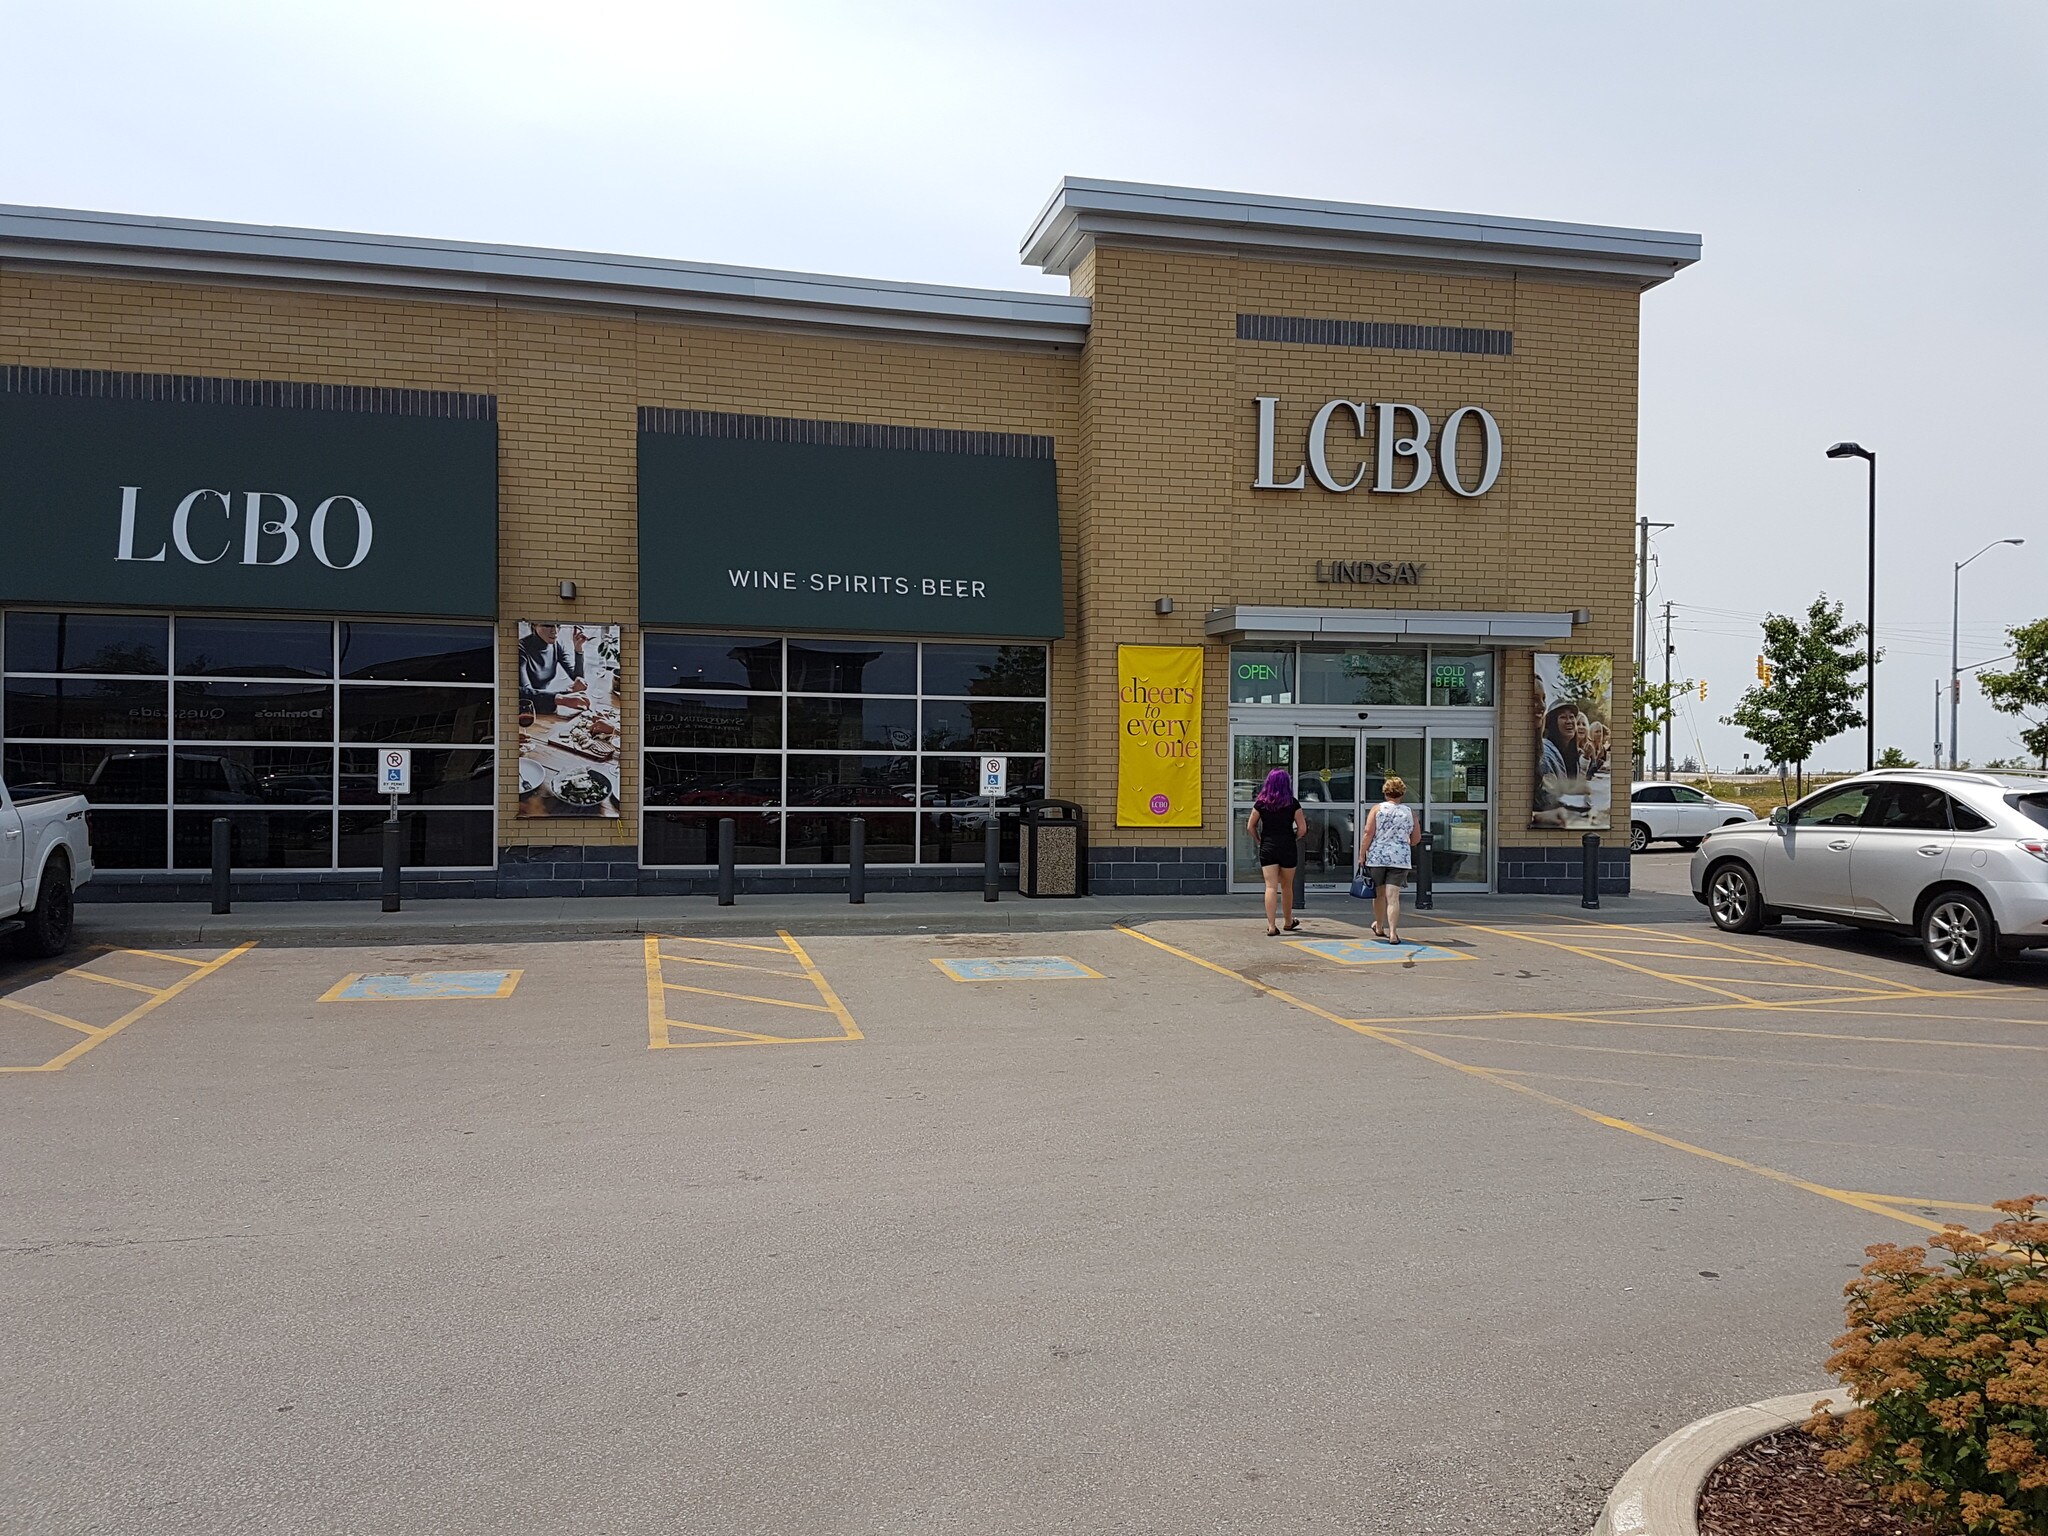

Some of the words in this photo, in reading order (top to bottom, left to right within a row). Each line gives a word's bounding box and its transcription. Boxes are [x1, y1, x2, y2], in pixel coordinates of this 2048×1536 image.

[1251, 396, 1503, 497] LCBO
[114, 486, 373, 569] LCBO
[728, 569, 797, 590] WINE
[810, 573, 909, 595] SPIRITS
[922, 578, 986, 598] BEER
[1315, 560, 1426, 585] LINDSAY
[1237, 664, 1278, 680] OPEN
[1435, 665, 1466, 677] COLD
[1435, 676, 1465, 688] BEER
[1120, 677, 1194, 704] cheers
[1145, 703, 1161, 719] to
[1127, 719, 1191, 743] every
[1155, 740, 1198, 759] one
